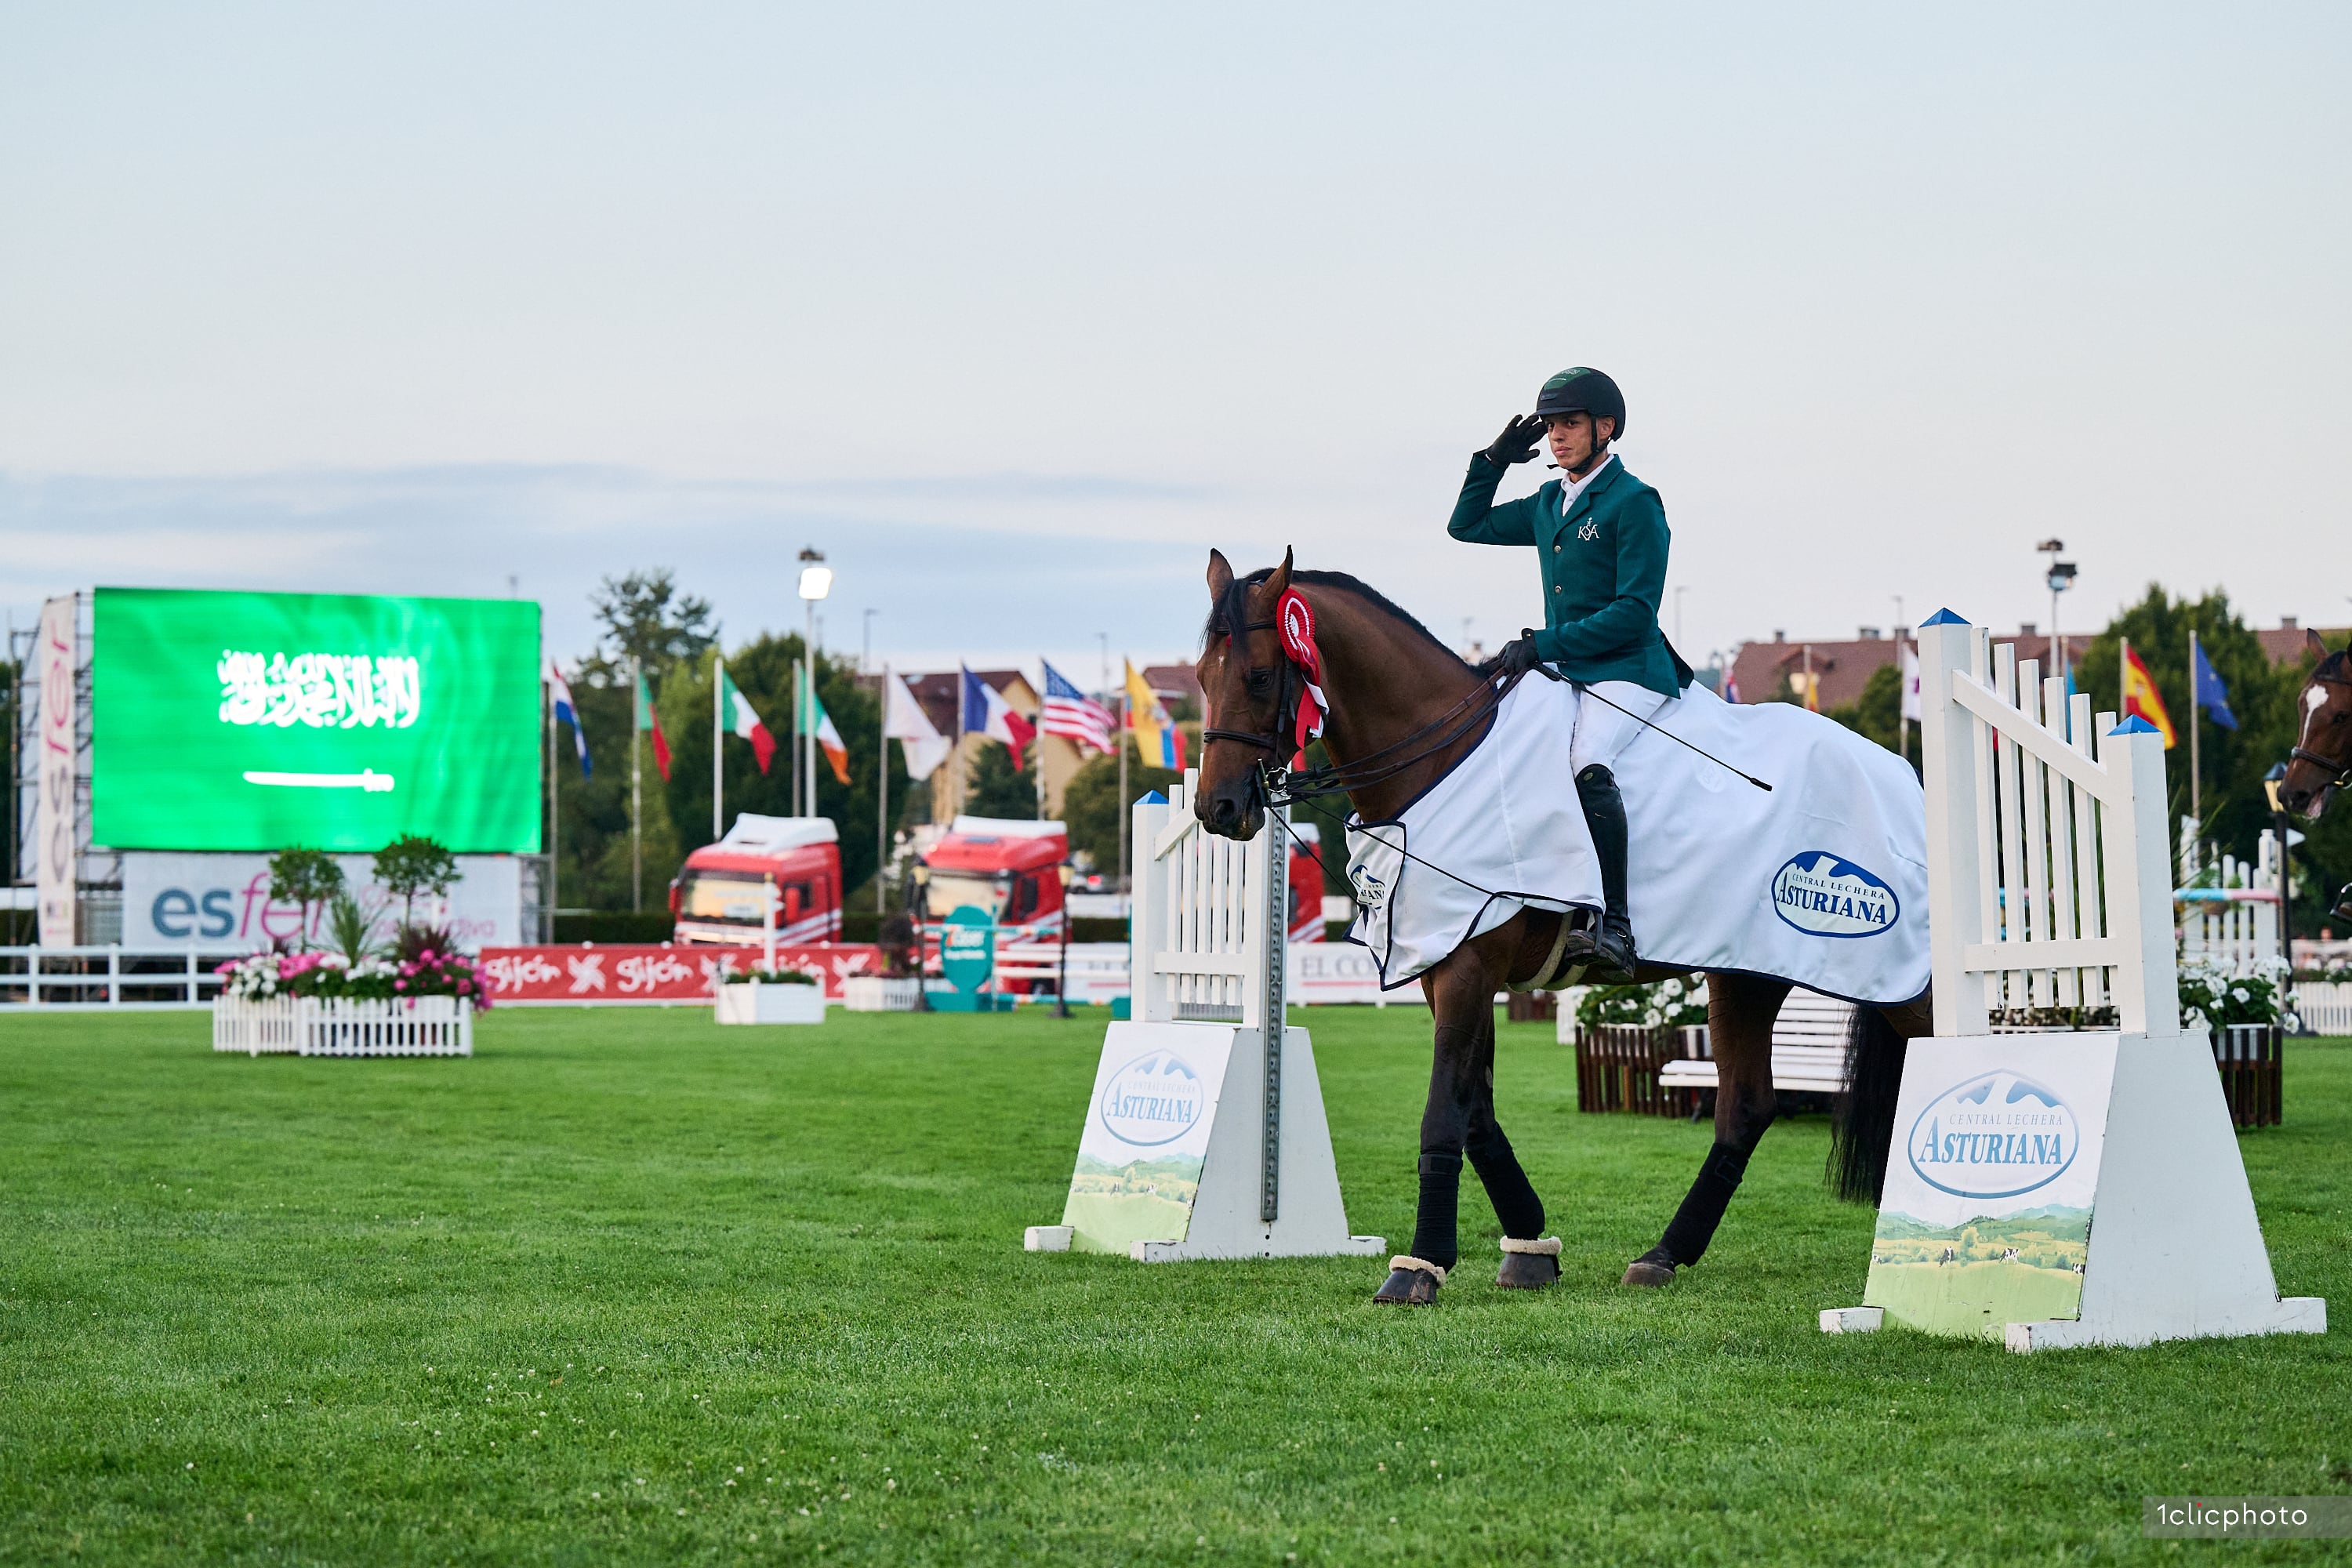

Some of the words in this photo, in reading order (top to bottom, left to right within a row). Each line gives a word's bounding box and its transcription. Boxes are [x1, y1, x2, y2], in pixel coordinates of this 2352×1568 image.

[1577, 523, 1600, 541] KSA
[1777, 872, 1887, 925] ASTURIANA
[1792, 873, 1826, 887] CENTRAL
[1831, 882, 1886, 899] LECHERA
[1105, 1081, 1192, 1123] ASTURIANA
[1949, 1113, 2002, 1126] CENTRAL
[2006, 1113, 2063, 1126] LECHERA
[1918, 1116, 2063, 1165] ASTURIANA
